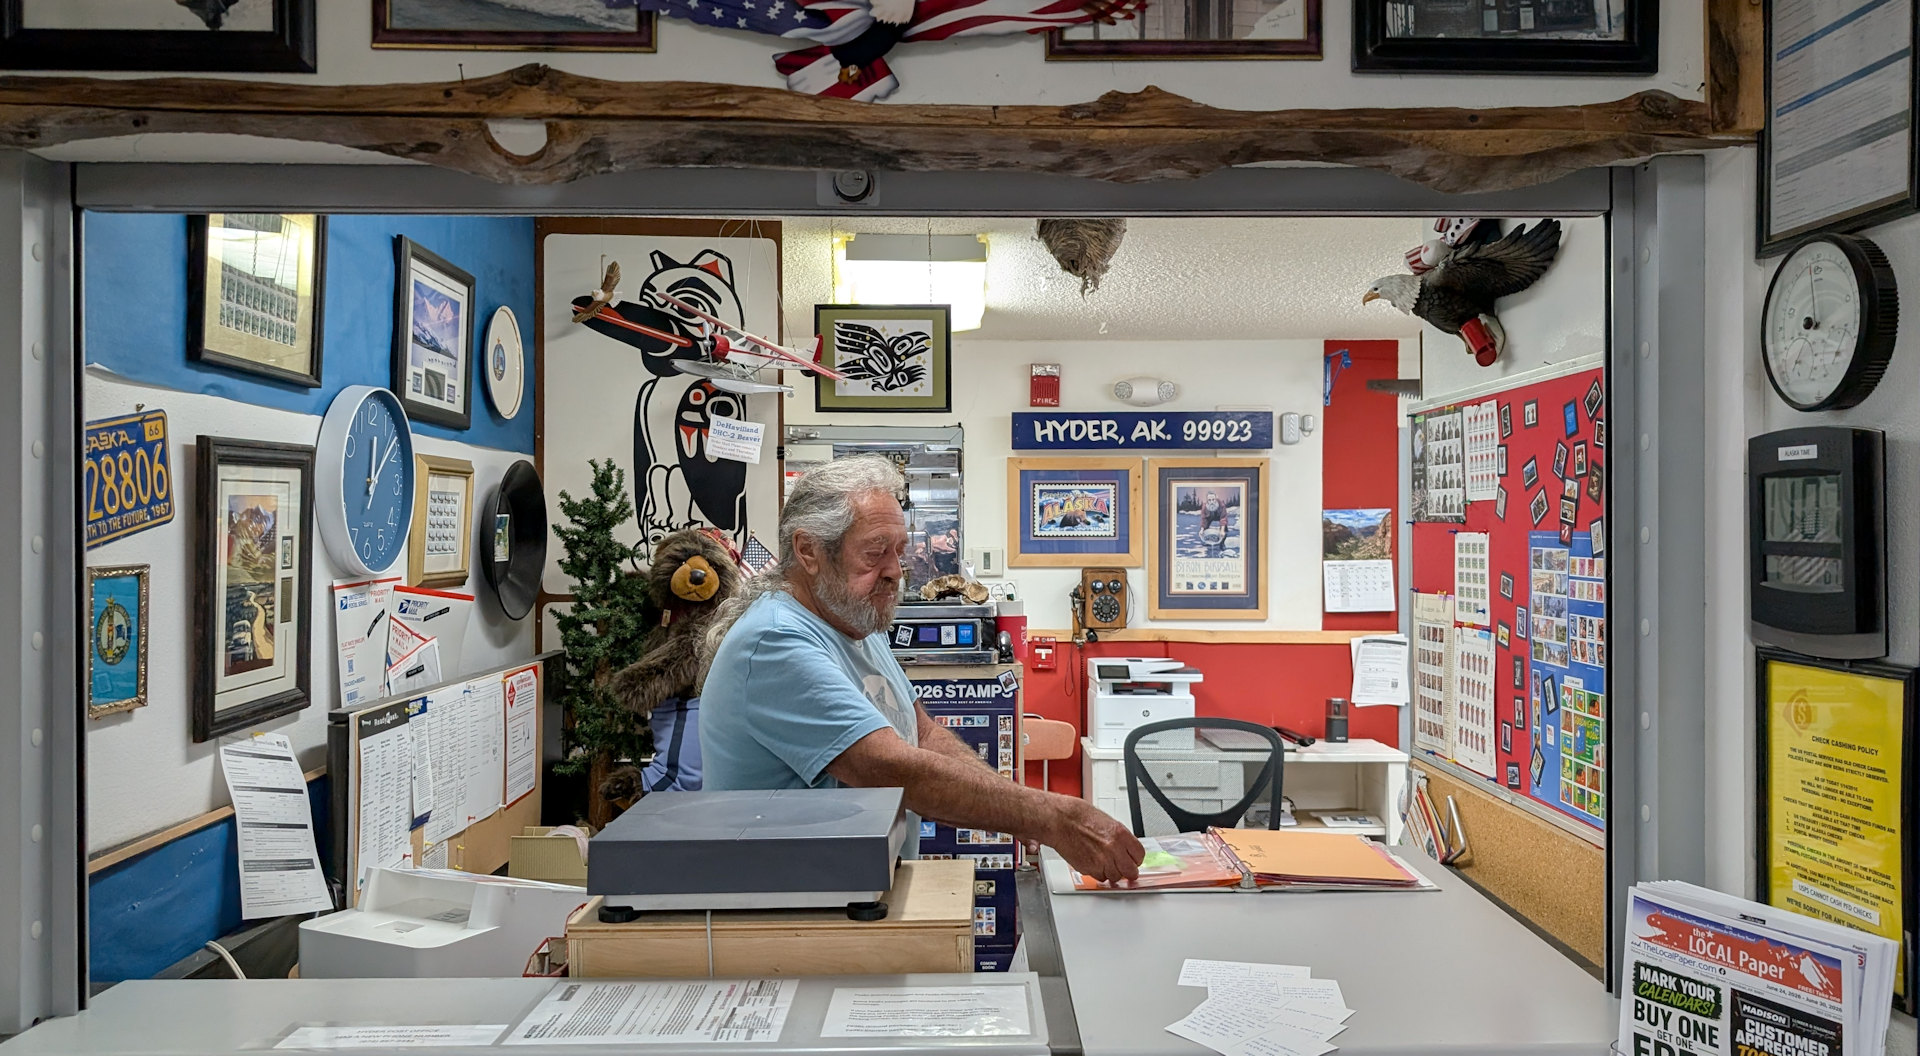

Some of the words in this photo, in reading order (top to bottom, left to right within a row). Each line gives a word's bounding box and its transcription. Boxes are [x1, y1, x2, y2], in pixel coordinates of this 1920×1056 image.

[368, 402, 378, 426] 12
[149, 425, 159, 437] 66
[713, 428, 735, 439] DHC-2
[738, 434, 760, 442] Beaver
[716, 421, 759, 434] DeHavilland
[1034, 420, 1125, 444] HYDER,
[1130, 420, 1172, 441] AK.
[1183, 420, 1252, 442] 99923
[86, 430, 136, 453] ASKA
[86, 442, 168, 521] 28806
[392, 474, 400, 496] 3
[99, 522, 107, 534] TO
[109, 518, 121, 532] THE
[151, 502, 169, 518] 1967
[388, 506, 395, 527] 4
[1041, 496, 1109, 526] ALASKA
[351, 528, 358, 550] 7
[364, 537, 371, 560] 6
[378, 529, 385, 551] 5
[1176, 561, 1200, 573] BYRON
[1204, 561, 1238, 573] BIRDSALL
[411, 600, 429, 609] PRIORITY
[392, 624, 410, 641] PRIORITY
[913, 684, 943, 698] 026
[1812, 736, 1830, 744] CHECK
[1831, 740, 1856, 751] CASHING
[1858, 746, 1878, 756] POLICY
[1853, 761, 1867, 769] CHECK
[1799, 884, 1809, 893] USPS
[1810, 888, 1828, 902] CANNOT
[1830, 897, 1842, 908] CASH
[1843, 903, 1852, 912] PFD
[1853, 907, 1872, 919] CHECKS
[1803, 904, 1820, 916] SORRY
[1822, 911, 1832, 922] FOR
[1834, 917, 1846, 926] ANY
[1693, 927, 1706, 938] the
[1643, 942, 1716, 974] TheLocalPaper.com
[1689, 934, 1735, 965] LOCAL
[1740, 950, 1785, 980] Paper
[1640, 966, 1677, 991] MARK
[1680, 979, 1715, 1002] YOUR
[1798, 984, 1815, 994] FREE!
[1639, 982, 1715, 1016] CALENDARS!
[1634, 999, 1672, 1031] BUY
[1679, 1016, 1719, 1049] ONE
[1743, 1004, 1786, 1024] MADISON
[1657, 1030, 1672, 1042] GET
[1676, 1036, 1693, 1050] ONE
[1745, 1019, 1829, 1056] CUSTOMER
